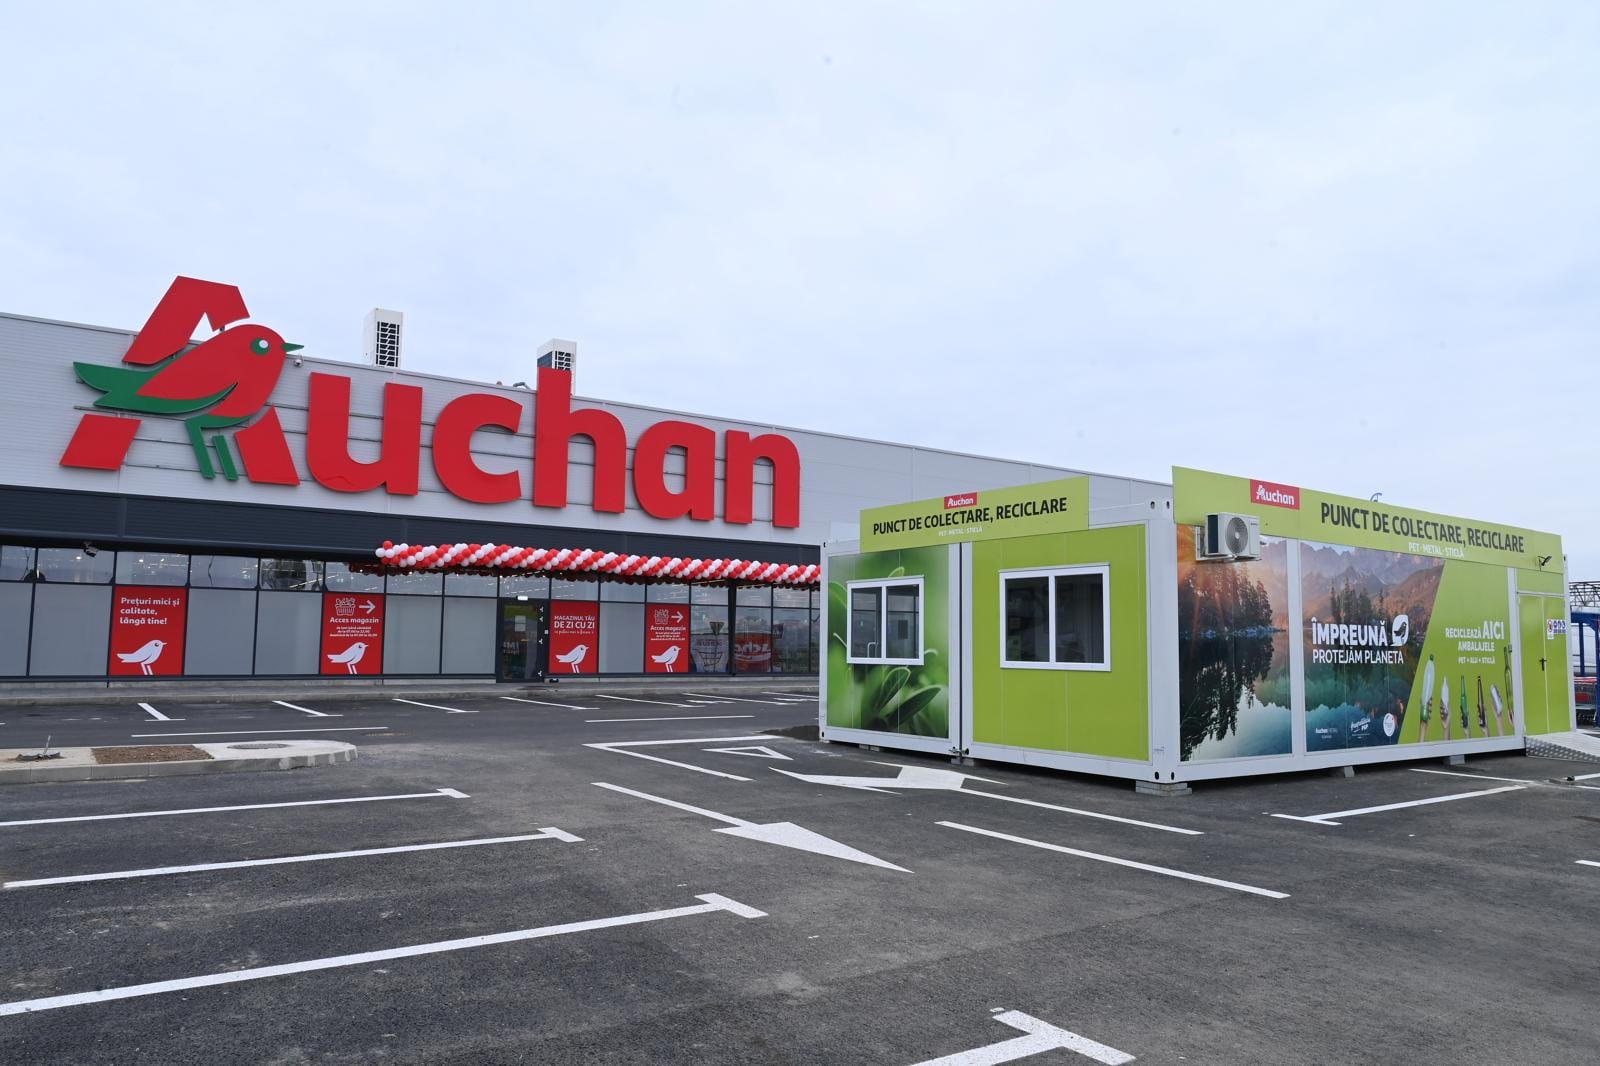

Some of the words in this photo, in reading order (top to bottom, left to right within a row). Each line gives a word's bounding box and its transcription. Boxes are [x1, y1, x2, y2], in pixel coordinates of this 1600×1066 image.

[60, 275, 800, 528] Auchan
[947, 497, 974, 507] Auchan
[1256, 484, 1294, 505] Auchan
[873, 519, 906, 536] PUNCT
[908, 516, 922, 531] DE
[924, 507, 993, 527] COLECTARE,
[996, 497, 1067, 520] RECICLARE
[1321, 502, 1369, 530] PUNCT
[1372, 511, 1390, 533] DE
[1392, 515, 1466, 548] COLECTARE,
[1468, 527, 1524, 553] RECICLARE
[153, 598, 171, 606] mici
[554, 620, 564, 629] DE
[565, 621, 574, 629] ZI
[575, 621, 586, 629] CU
[587, 621, 595, 629] ZI
[1311, 616, 1388, 646] ÎMPREUNĂ
[1482, 620, 1505, 640] AICI
[1364, 650, 1404, 664] PLANETA
